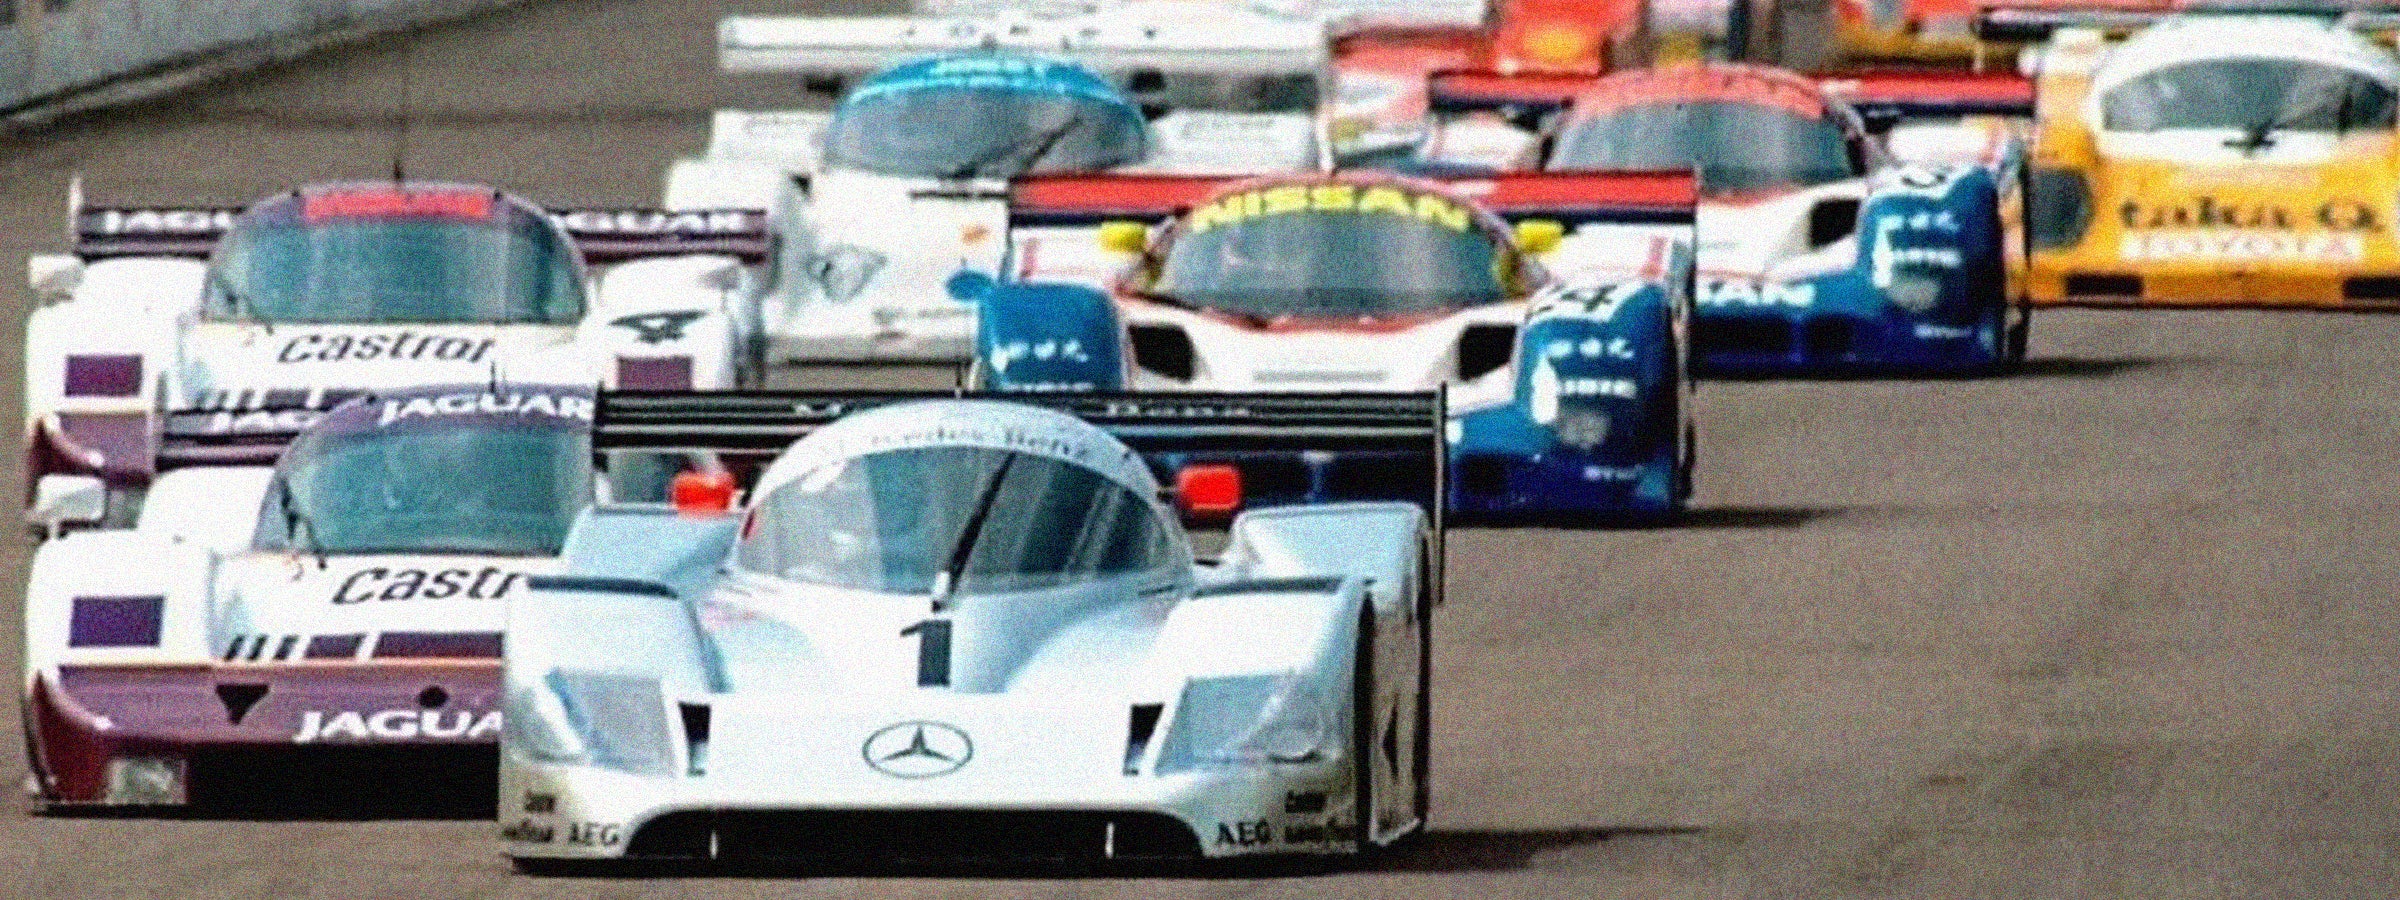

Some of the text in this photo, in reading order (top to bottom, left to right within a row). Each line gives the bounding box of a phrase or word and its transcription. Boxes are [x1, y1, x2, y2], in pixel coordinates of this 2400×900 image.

[1190, 183, 1469, 233] NISSAN
[605, 311, 709, 346] 4
[377, 393, 597, 427] JAGUAR
[899, 619, 953, 688] 1
[568, 822, 623, 847] AEG
[1215, 820, 1271, 846] AEG
